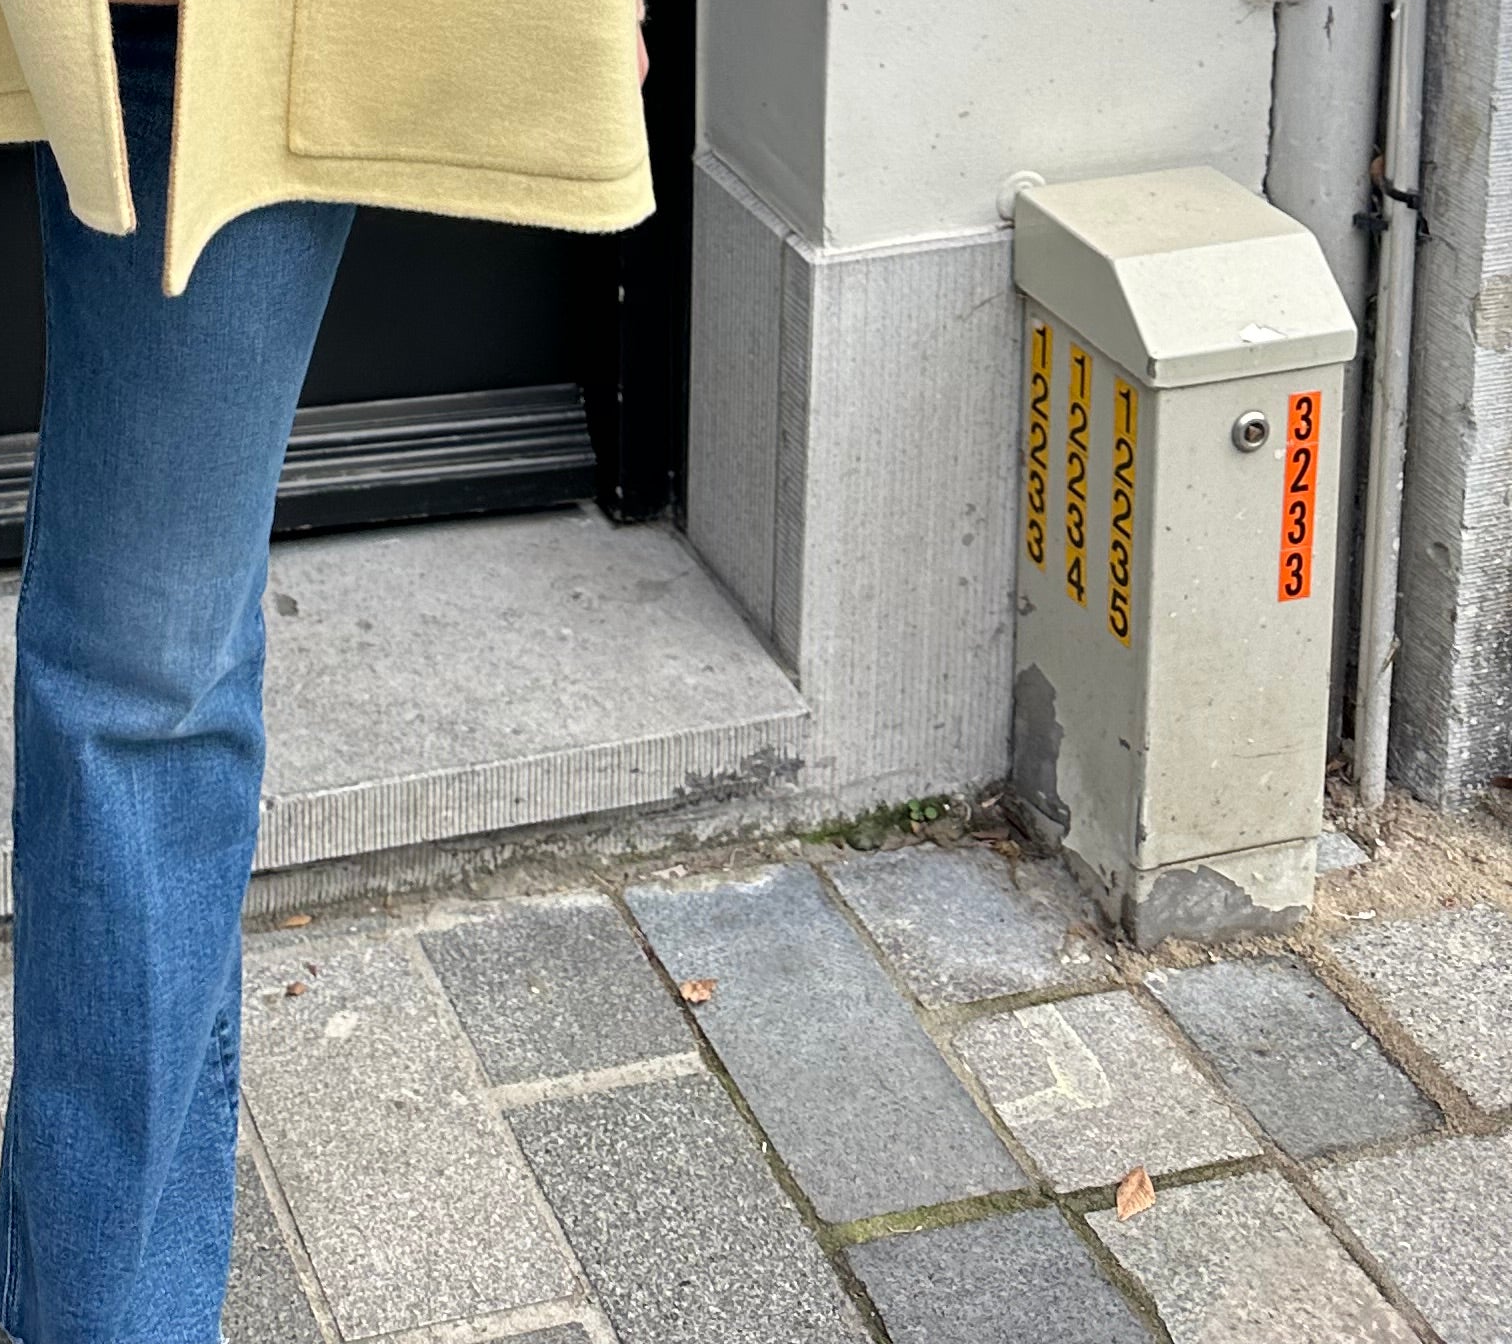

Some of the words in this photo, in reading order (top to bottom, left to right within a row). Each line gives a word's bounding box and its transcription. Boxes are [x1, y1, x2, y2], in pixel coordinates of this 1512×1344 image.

[1027, 326, 1049, 564] 12233
[1066, 354, 1088, 602] 12234
[1110, 389, 1133, 638] 12235
[1284, 396, 1313, 597] 3233
